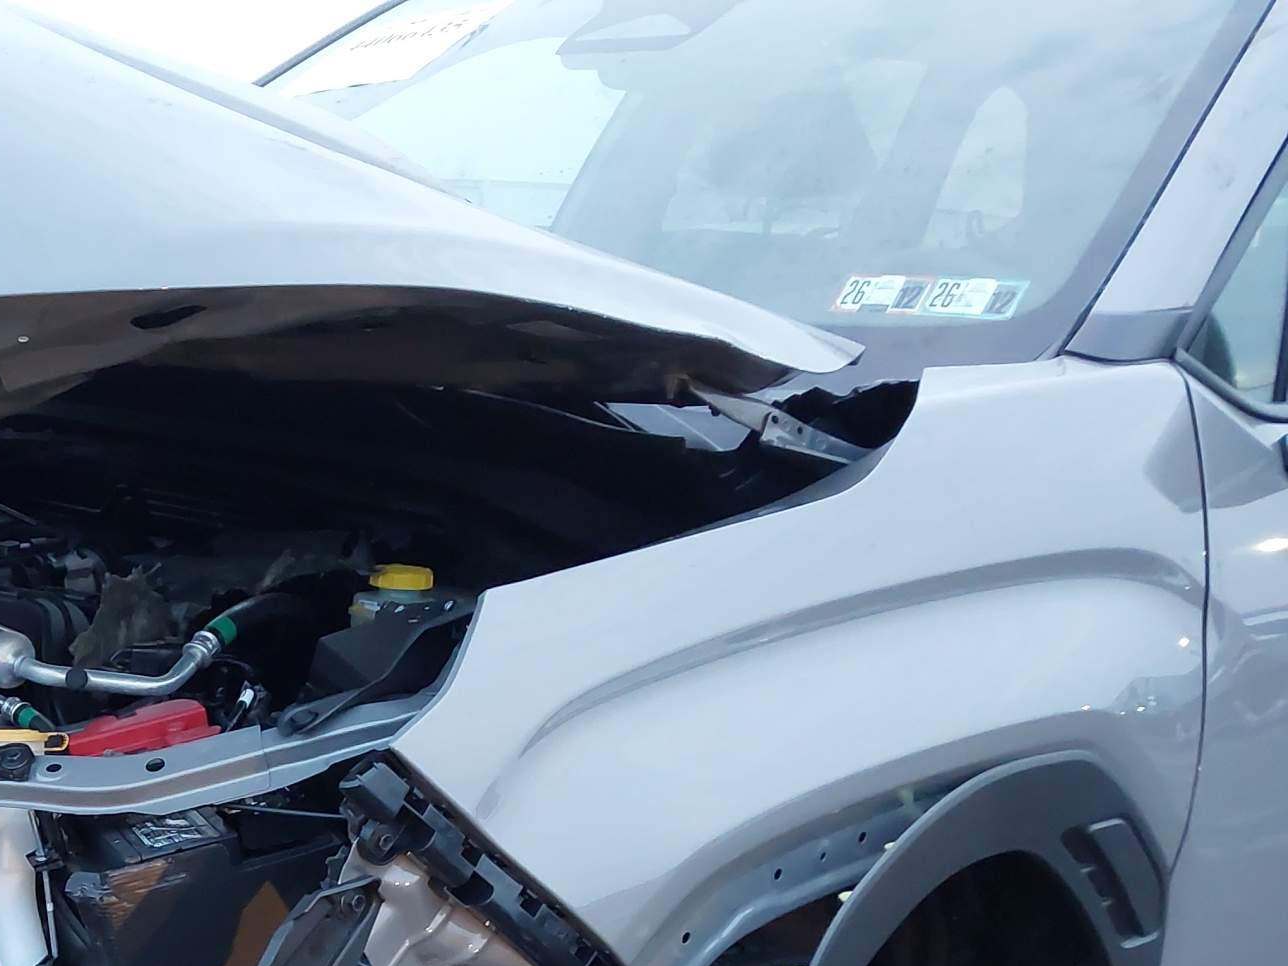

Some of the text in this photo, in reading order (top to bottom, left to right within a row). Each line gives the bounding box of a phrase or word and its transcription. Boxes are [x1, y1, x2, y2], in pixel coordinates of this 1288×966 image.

[840, 279, 924, 309] 26 12
[928, 282, 1017, 314] 26 12
